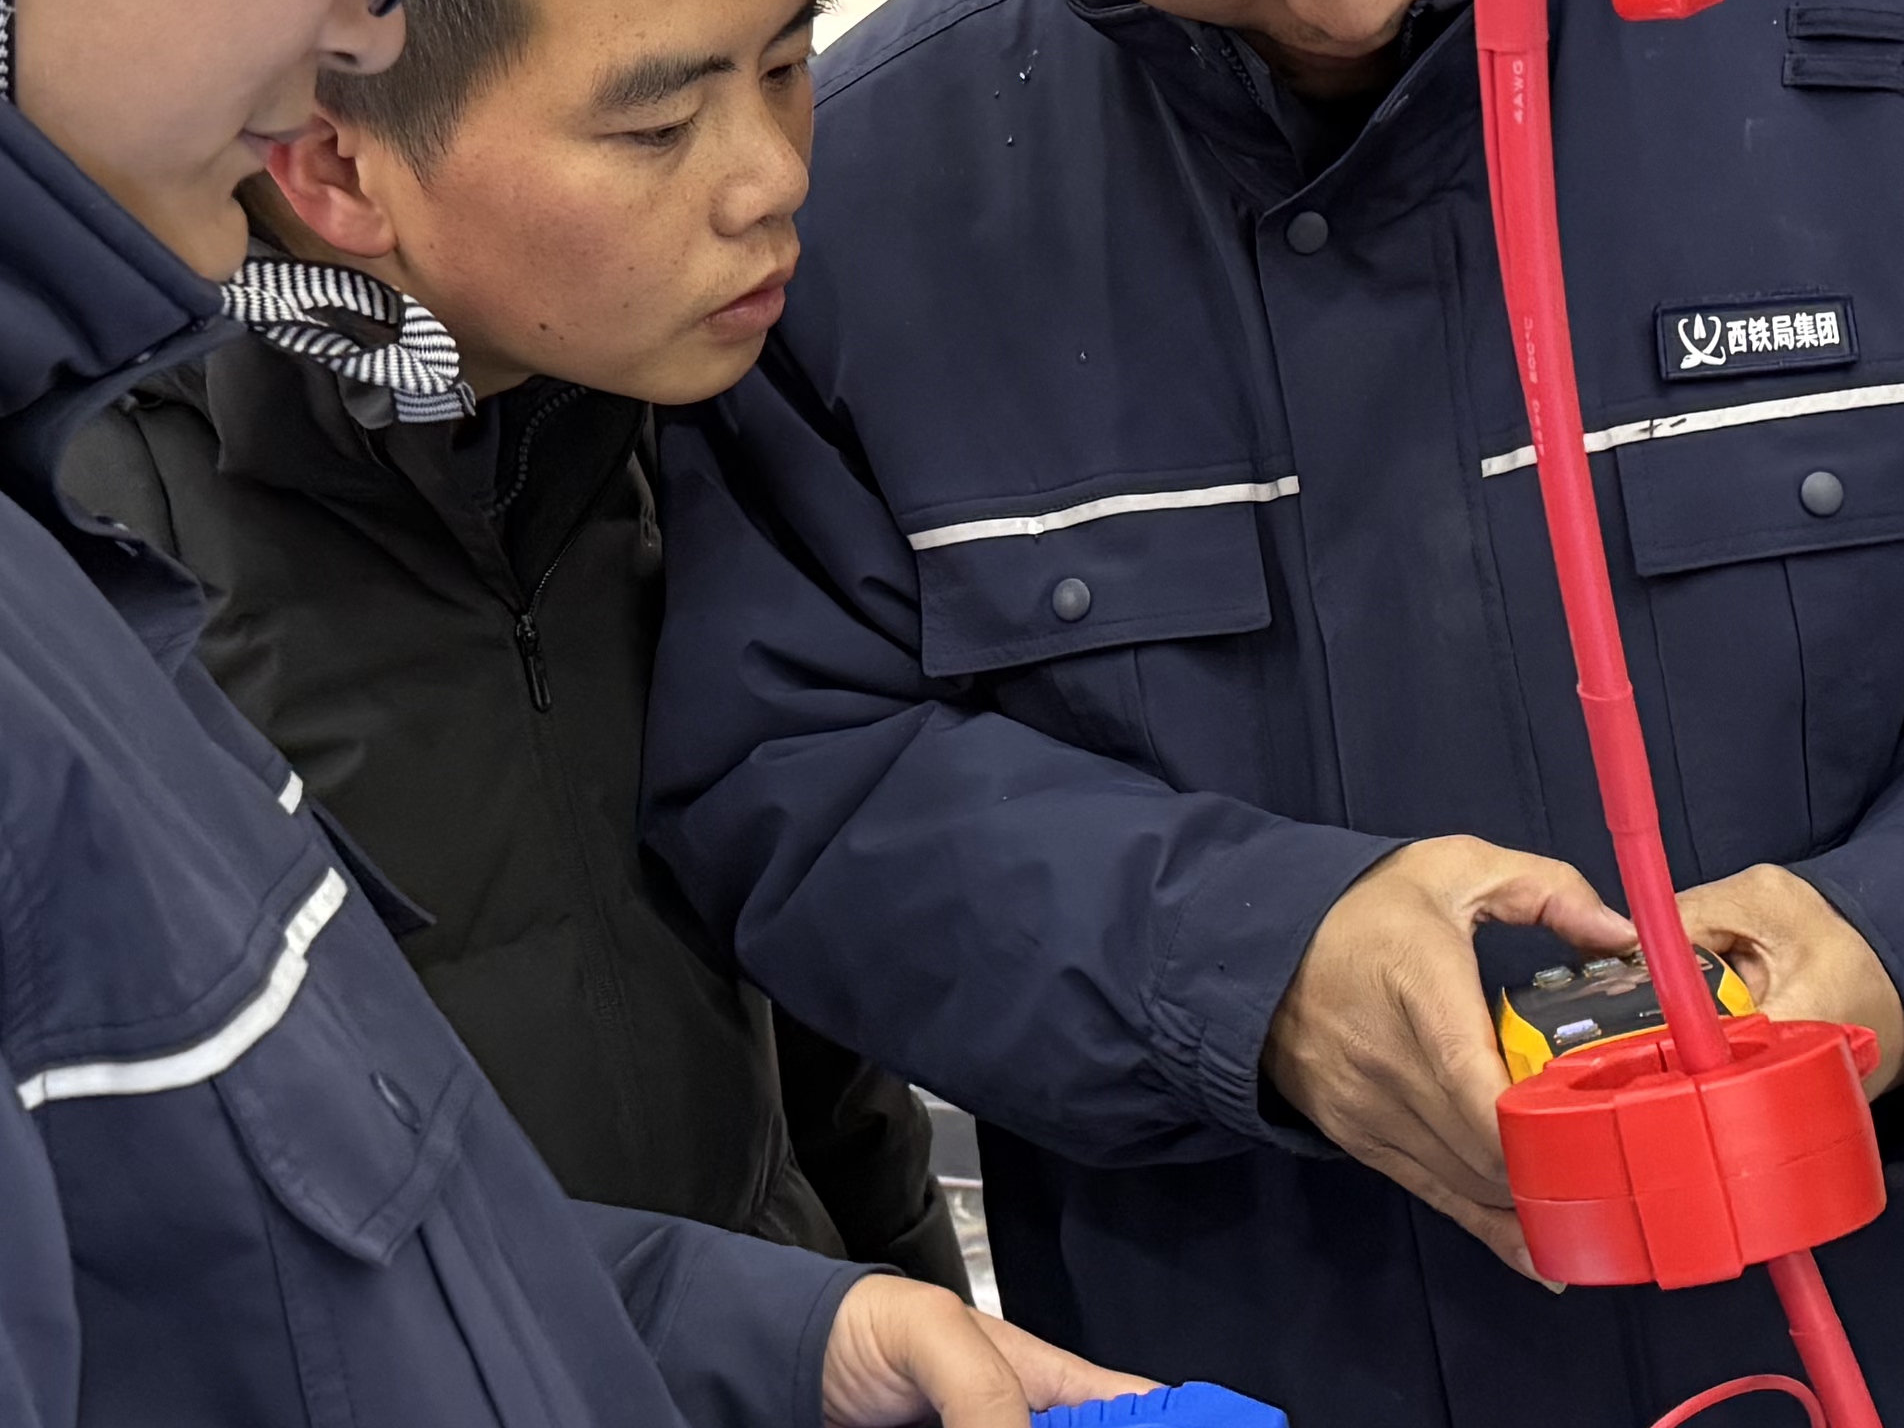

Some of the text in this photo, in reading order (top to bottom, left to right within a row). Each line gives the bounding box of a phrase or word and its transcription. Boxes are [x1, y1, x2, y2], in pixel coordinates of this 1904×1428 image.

[1513, 59, 1524, 125] 4AWG
[1726, 311, 1840, 356] 西铁局集团
